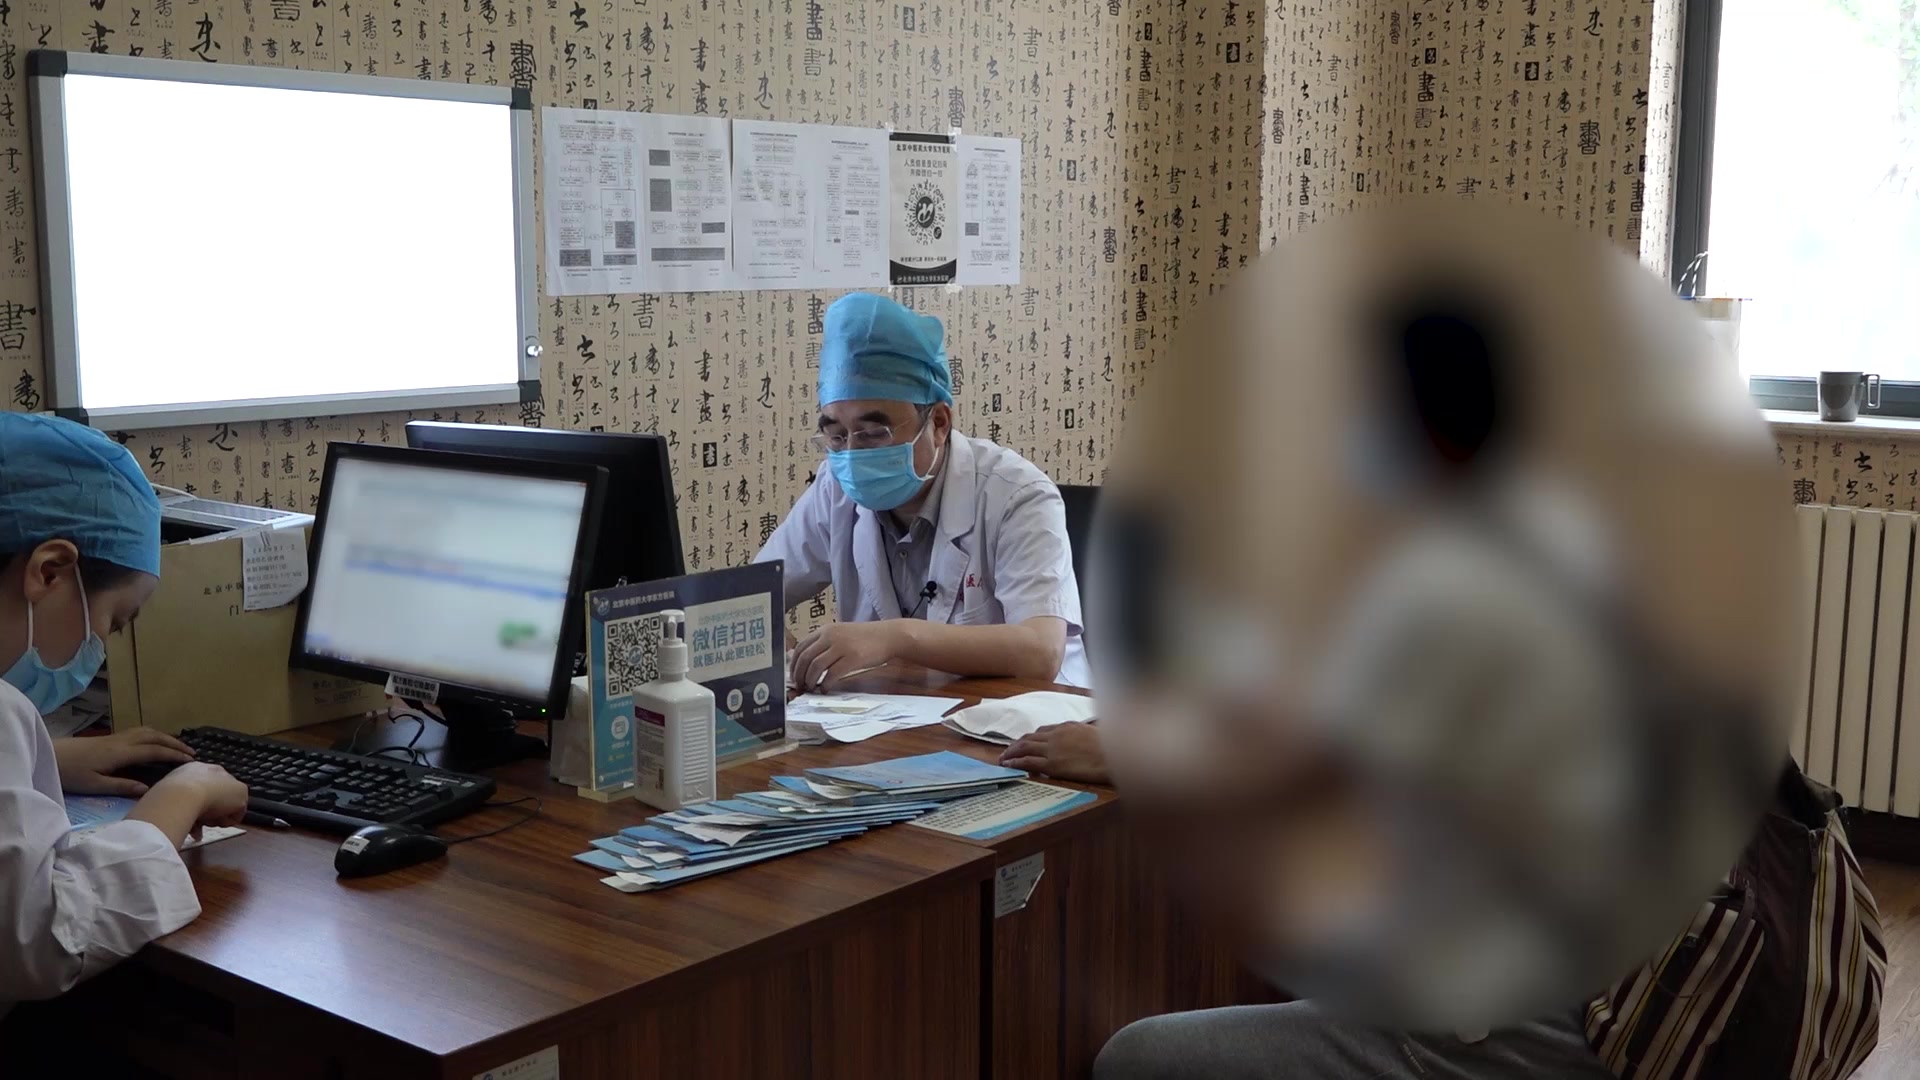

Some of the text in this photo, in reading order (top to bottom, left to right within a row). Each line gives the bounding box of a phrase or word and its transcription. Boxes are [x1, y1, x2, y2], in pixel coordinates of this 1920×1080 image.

[692, 617, 765, 653] 微信扫码
[693, 642, 766, 668] 就医从此更轻松
